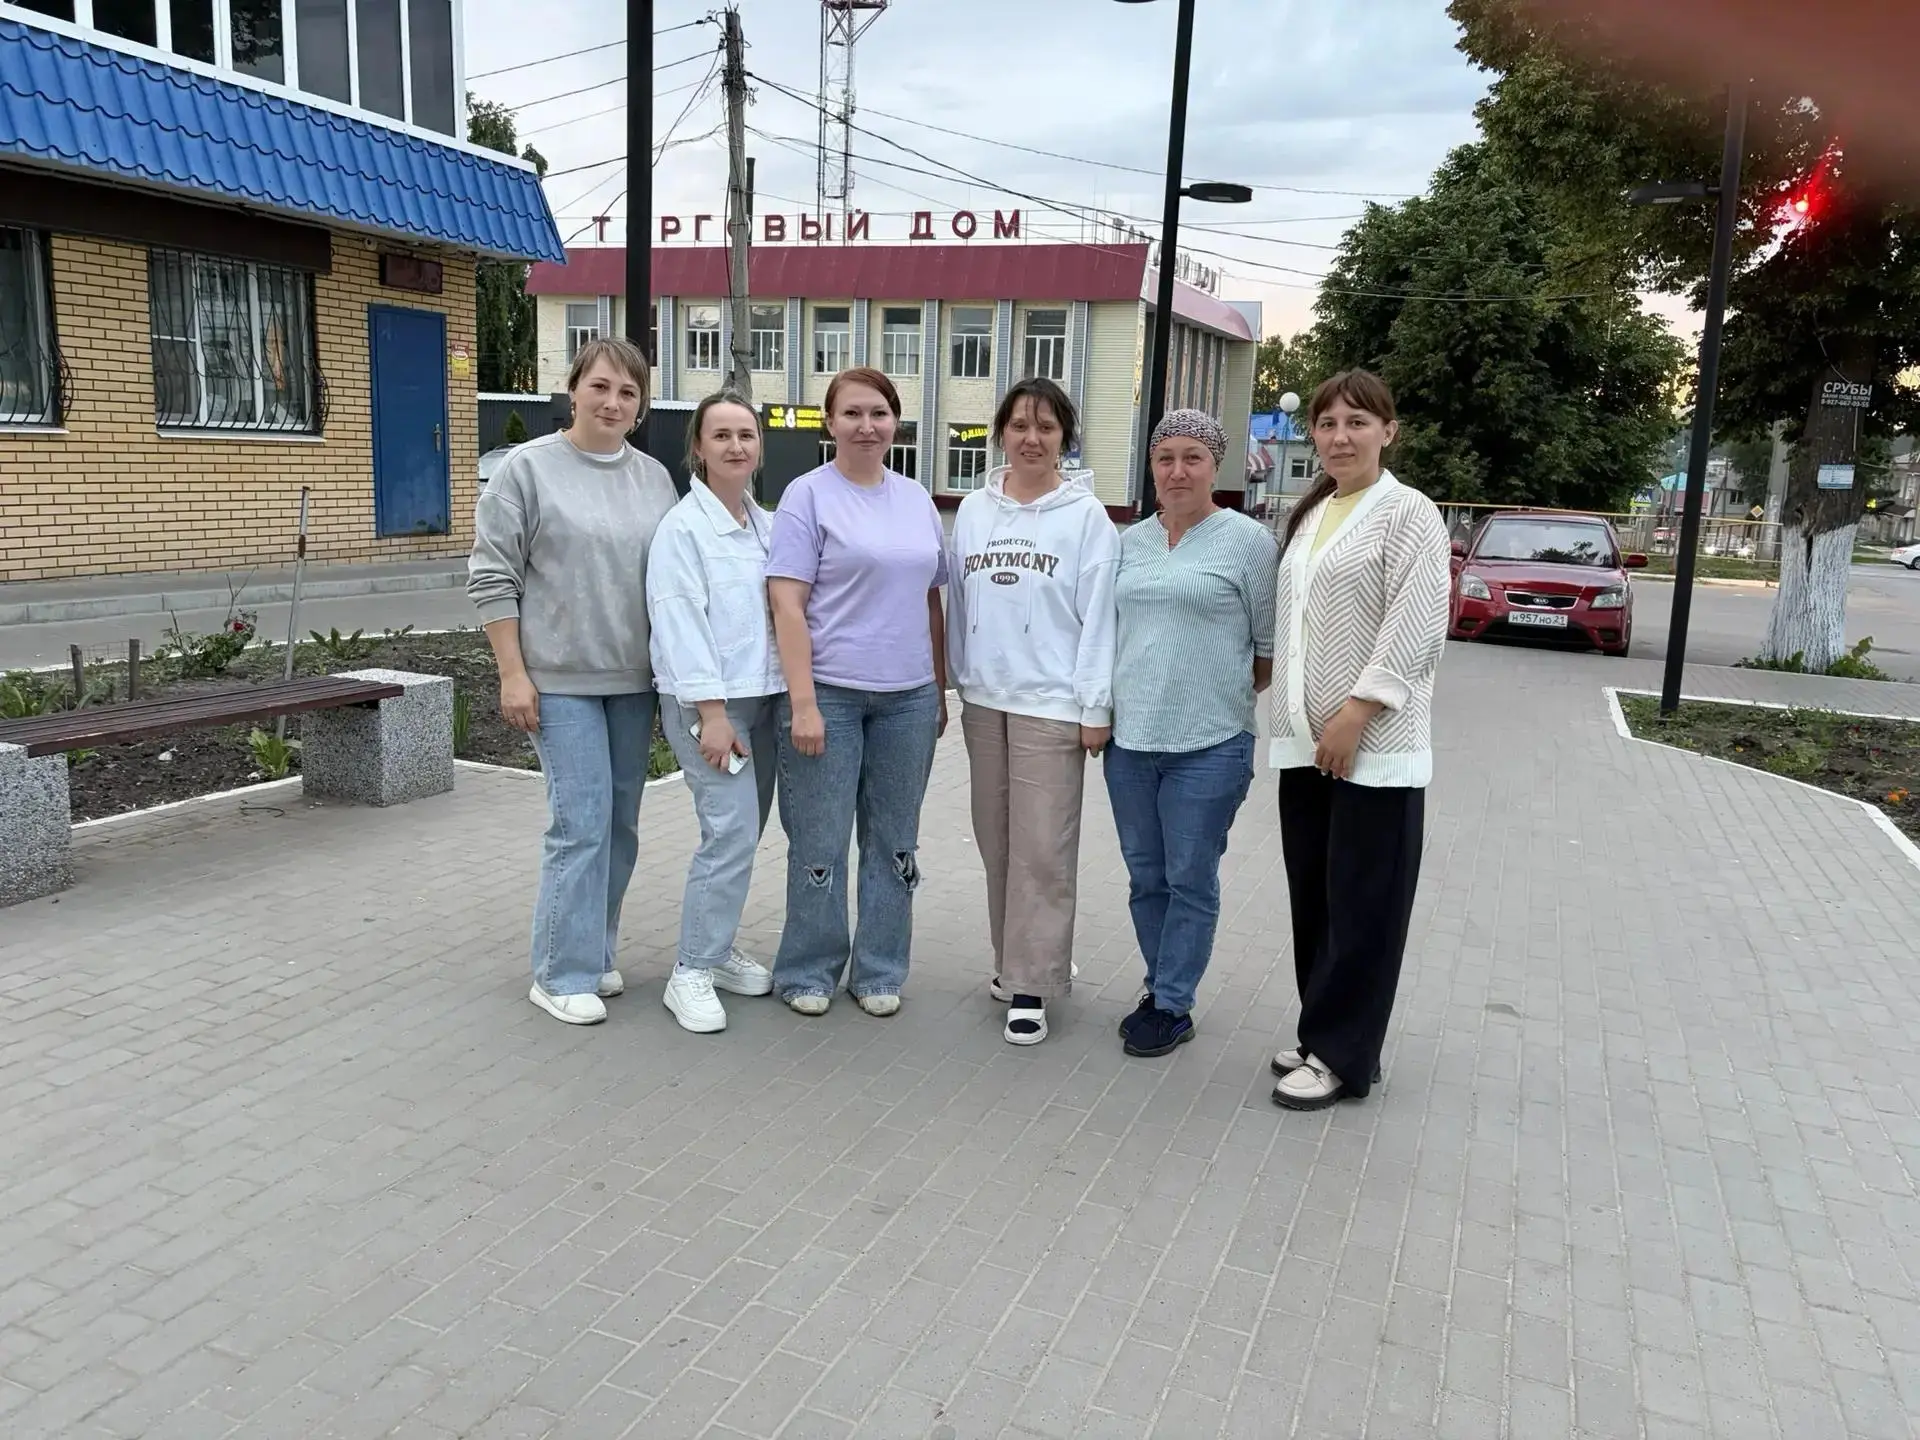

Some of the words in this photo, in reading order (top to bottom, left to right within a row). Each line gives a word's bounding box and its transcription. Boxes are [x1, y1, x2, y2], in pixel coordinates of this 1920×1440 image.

[592, 208, 870, 242] ТРГВЫЙ
[909, 208, 1021, 240] ДОМ
[1823, 382, 1872, 396] СРУБЫ
[994, 575, 1016, 583] 1998
